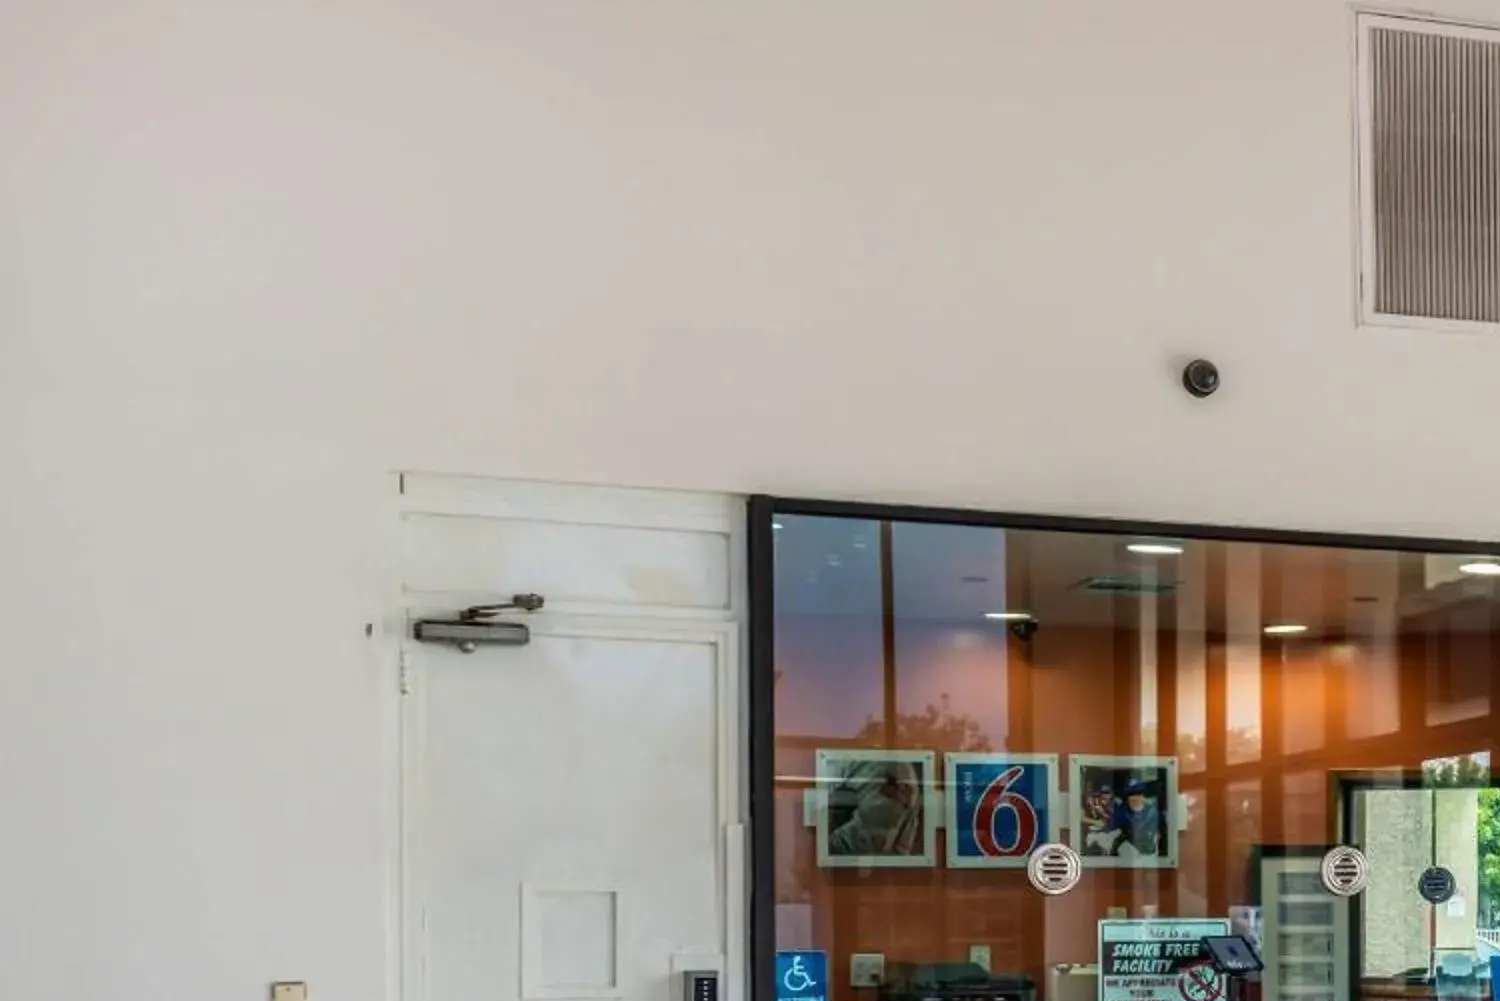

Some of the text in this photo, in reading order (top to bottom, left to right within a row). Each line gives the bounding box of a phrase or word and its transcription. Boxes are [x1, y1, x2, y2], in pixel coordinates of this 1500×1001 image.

[973, 766, 1038, 857] 6
[1112, 944, 1200, 957] SMOKE FREE
[1112, 960, 1173, 973] FACILITY
